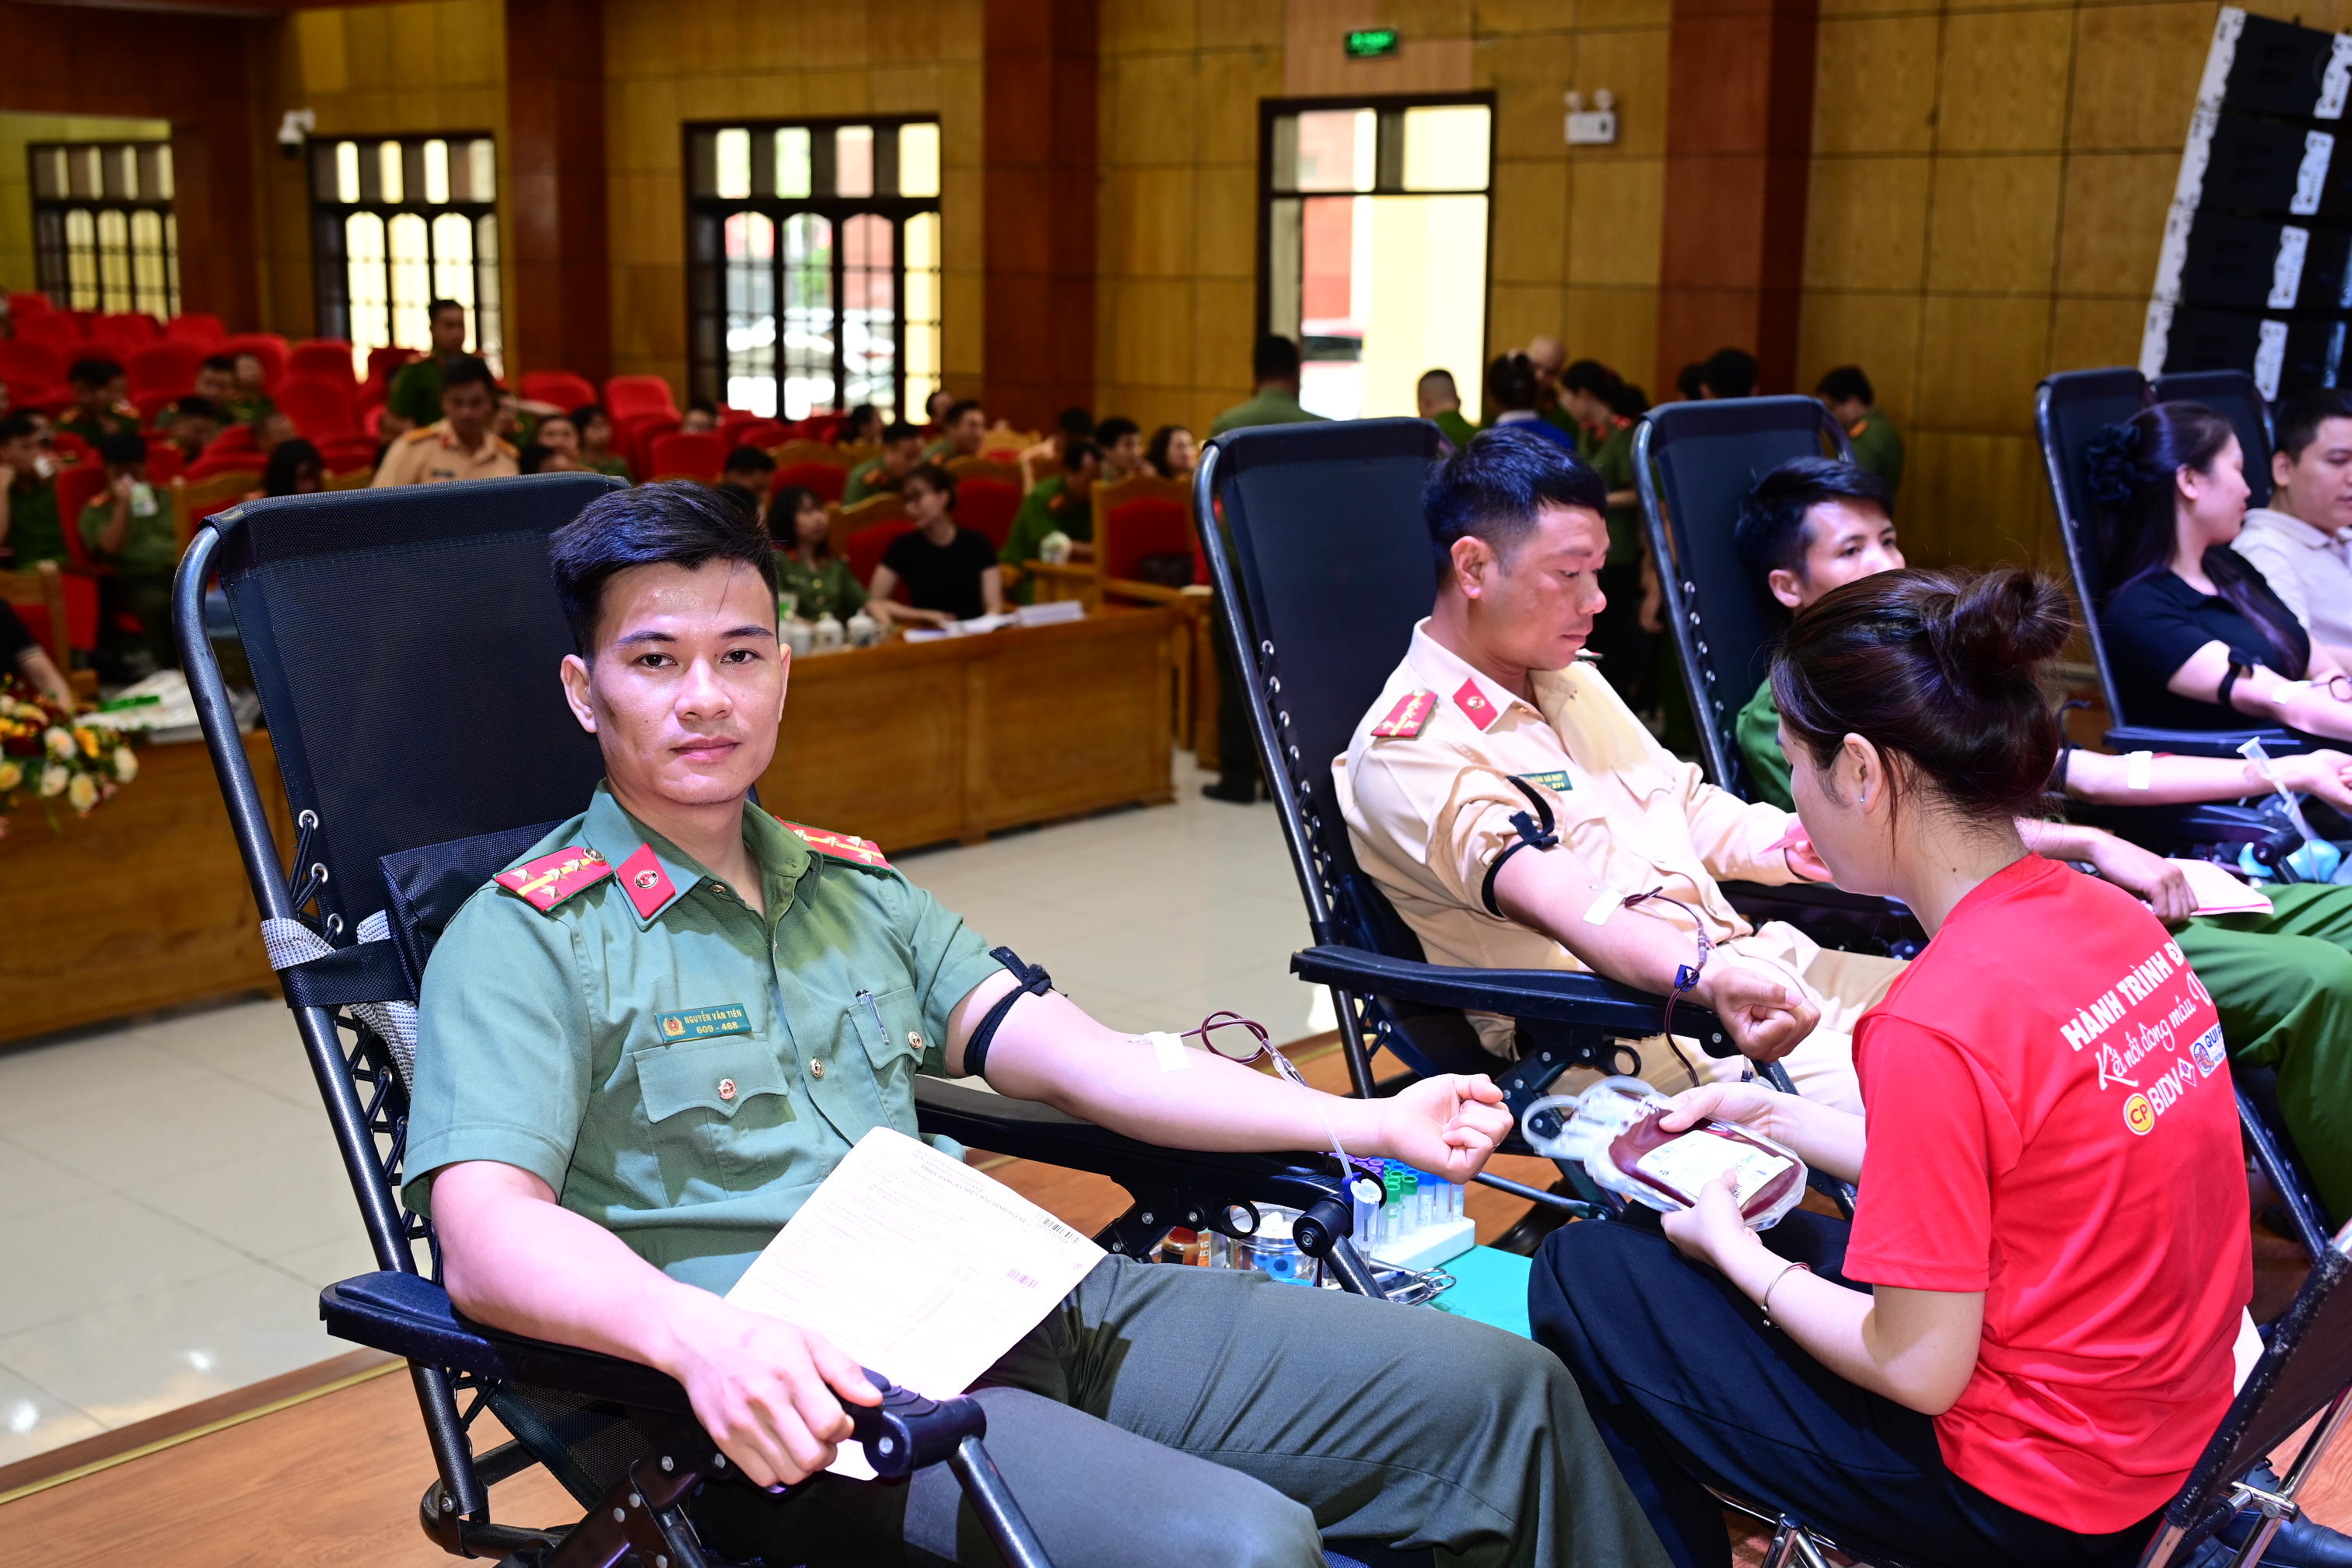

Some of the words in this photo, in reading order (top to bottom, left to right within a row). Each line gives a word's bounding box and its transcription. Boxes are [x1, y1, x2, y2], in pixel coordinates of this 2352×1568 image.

[2060, 990, 2126, 1052] HÀNH
[2116, 950, 2174, 1006] TRÌNH
[2163, 937, 2185, 967] Đ
[684, 1011, 711, 1024] NGUYỄN
[712, 1010, 726, 1021] VĂN
[727, 1008, 742, 1018] TIẾN
[696, 1024, 714, 1034] 609
[721, 1021, 738, 1031] 468
[2095, 1042, 2139, 1090] Kết
[2123, 1031, 2144, 1068] nối
[2138, 1022, 2175, 1052] dòng
[2168, 996, 2196, 1028] máu
[2147, 1067, 2184, 1116] BIDV
[2130, 1103, 2147, 1124] CP
